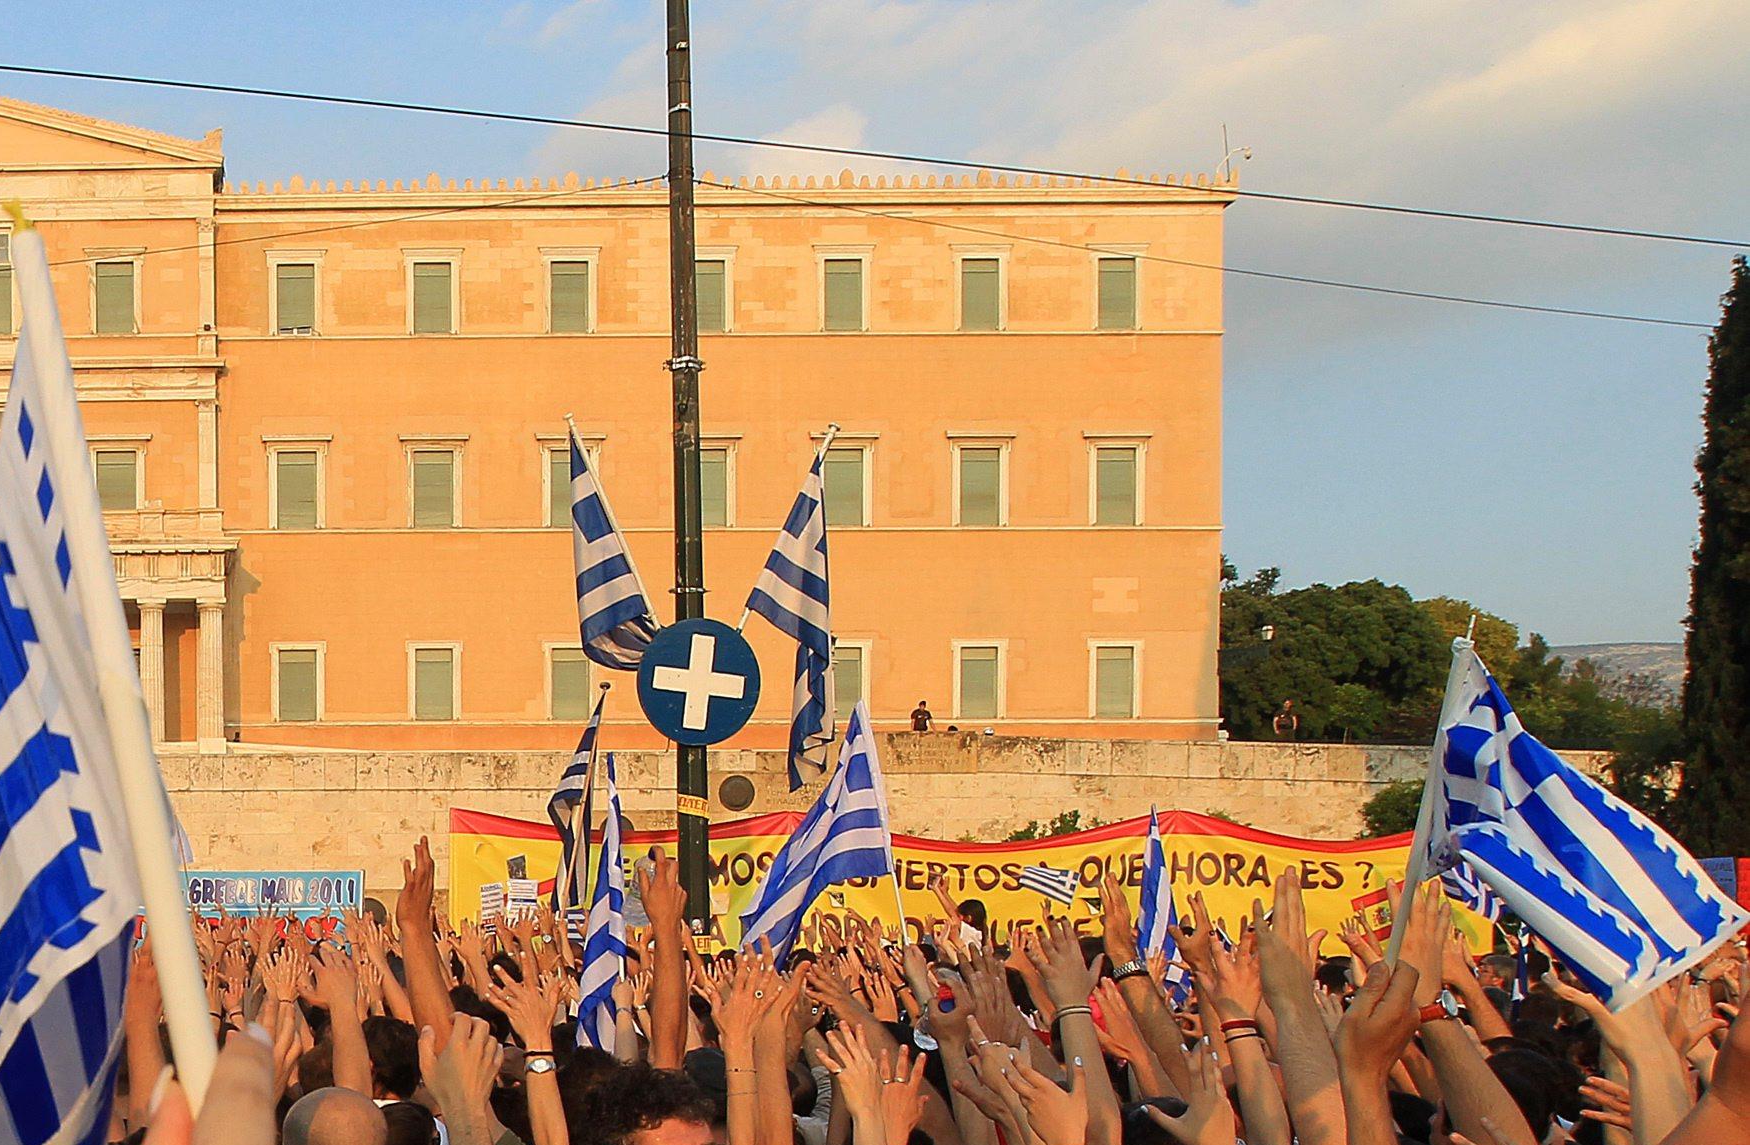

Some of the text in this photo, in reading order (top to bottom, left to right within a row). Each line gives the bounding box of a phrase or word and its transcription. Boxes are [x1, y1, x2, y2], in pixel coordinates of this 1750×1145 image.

[1171, 851, 1271, 888] HORA
[1300, 860, 1344, 890] ES
[188, 877, 257, 904] GREECE
[308, 877, 356, 904] 2011
